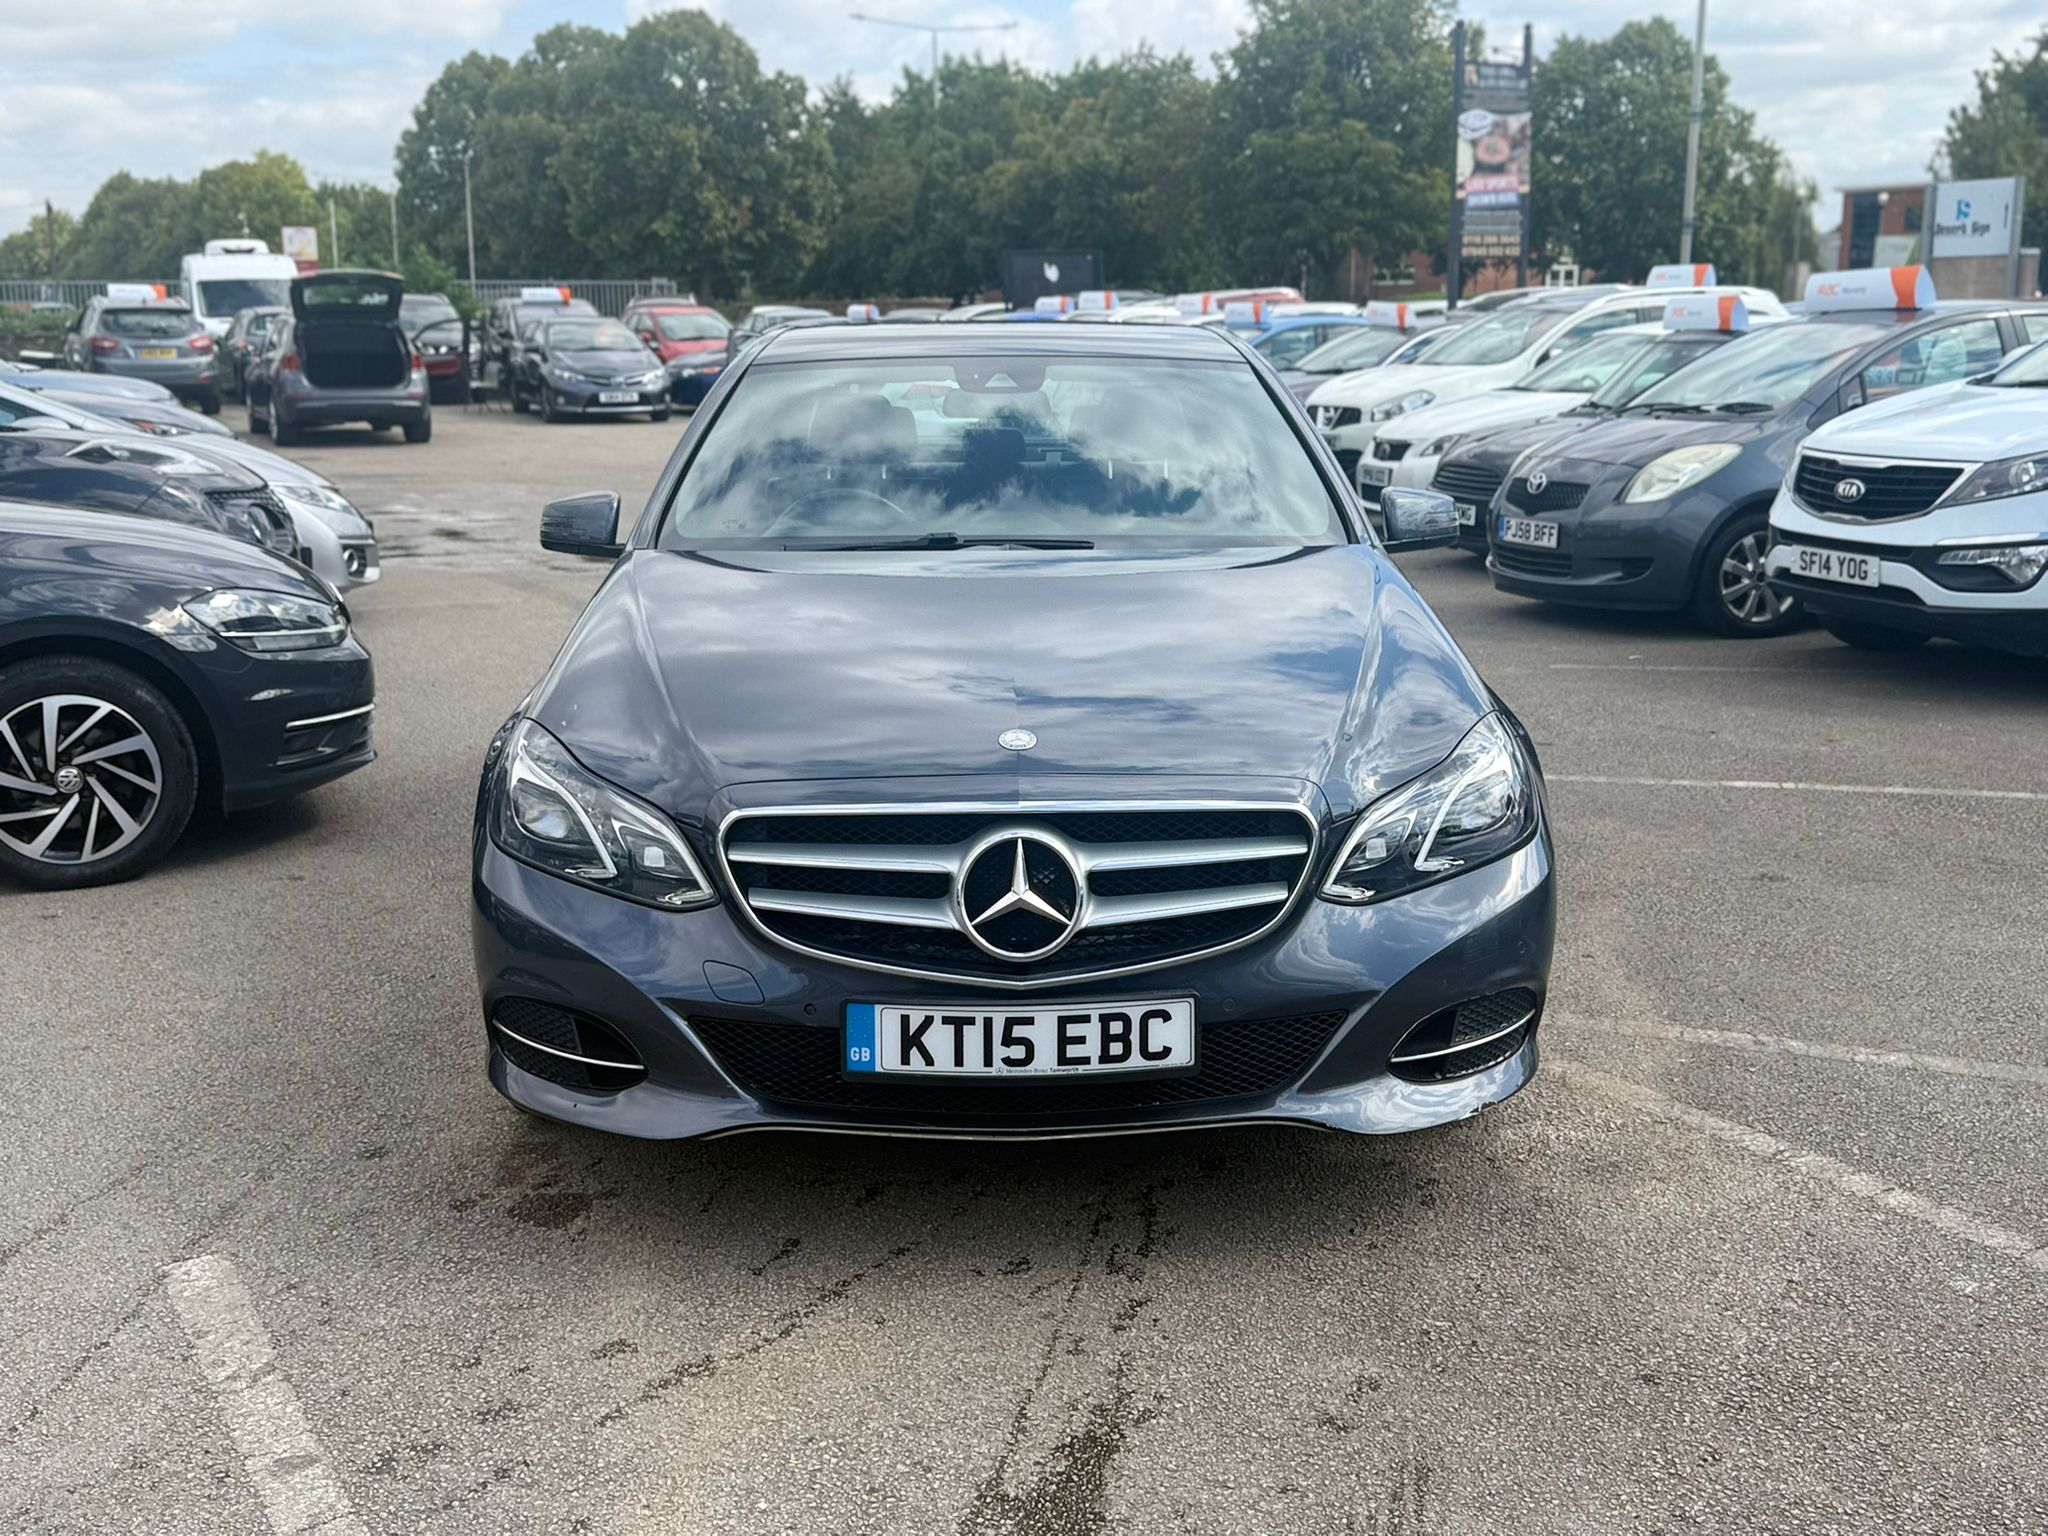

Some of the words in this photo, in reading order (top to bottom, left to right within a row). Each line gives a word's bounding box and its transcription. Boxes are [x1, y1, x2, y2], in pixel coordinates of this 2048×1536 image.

[1838, 484, 1860, 497] KIA
[1505, 524, 1531, 541] PJ58
[1533, 524, 1556, 543] BFF
[1800, 551, 1831, 575] SF14
[1837, 555, 1868, 580] YOG
[900, 1013, 1035, 1068] KT15
[1057, 1008, 1173, 1067] EBC
[850, 1047, 871, 1062] GB
